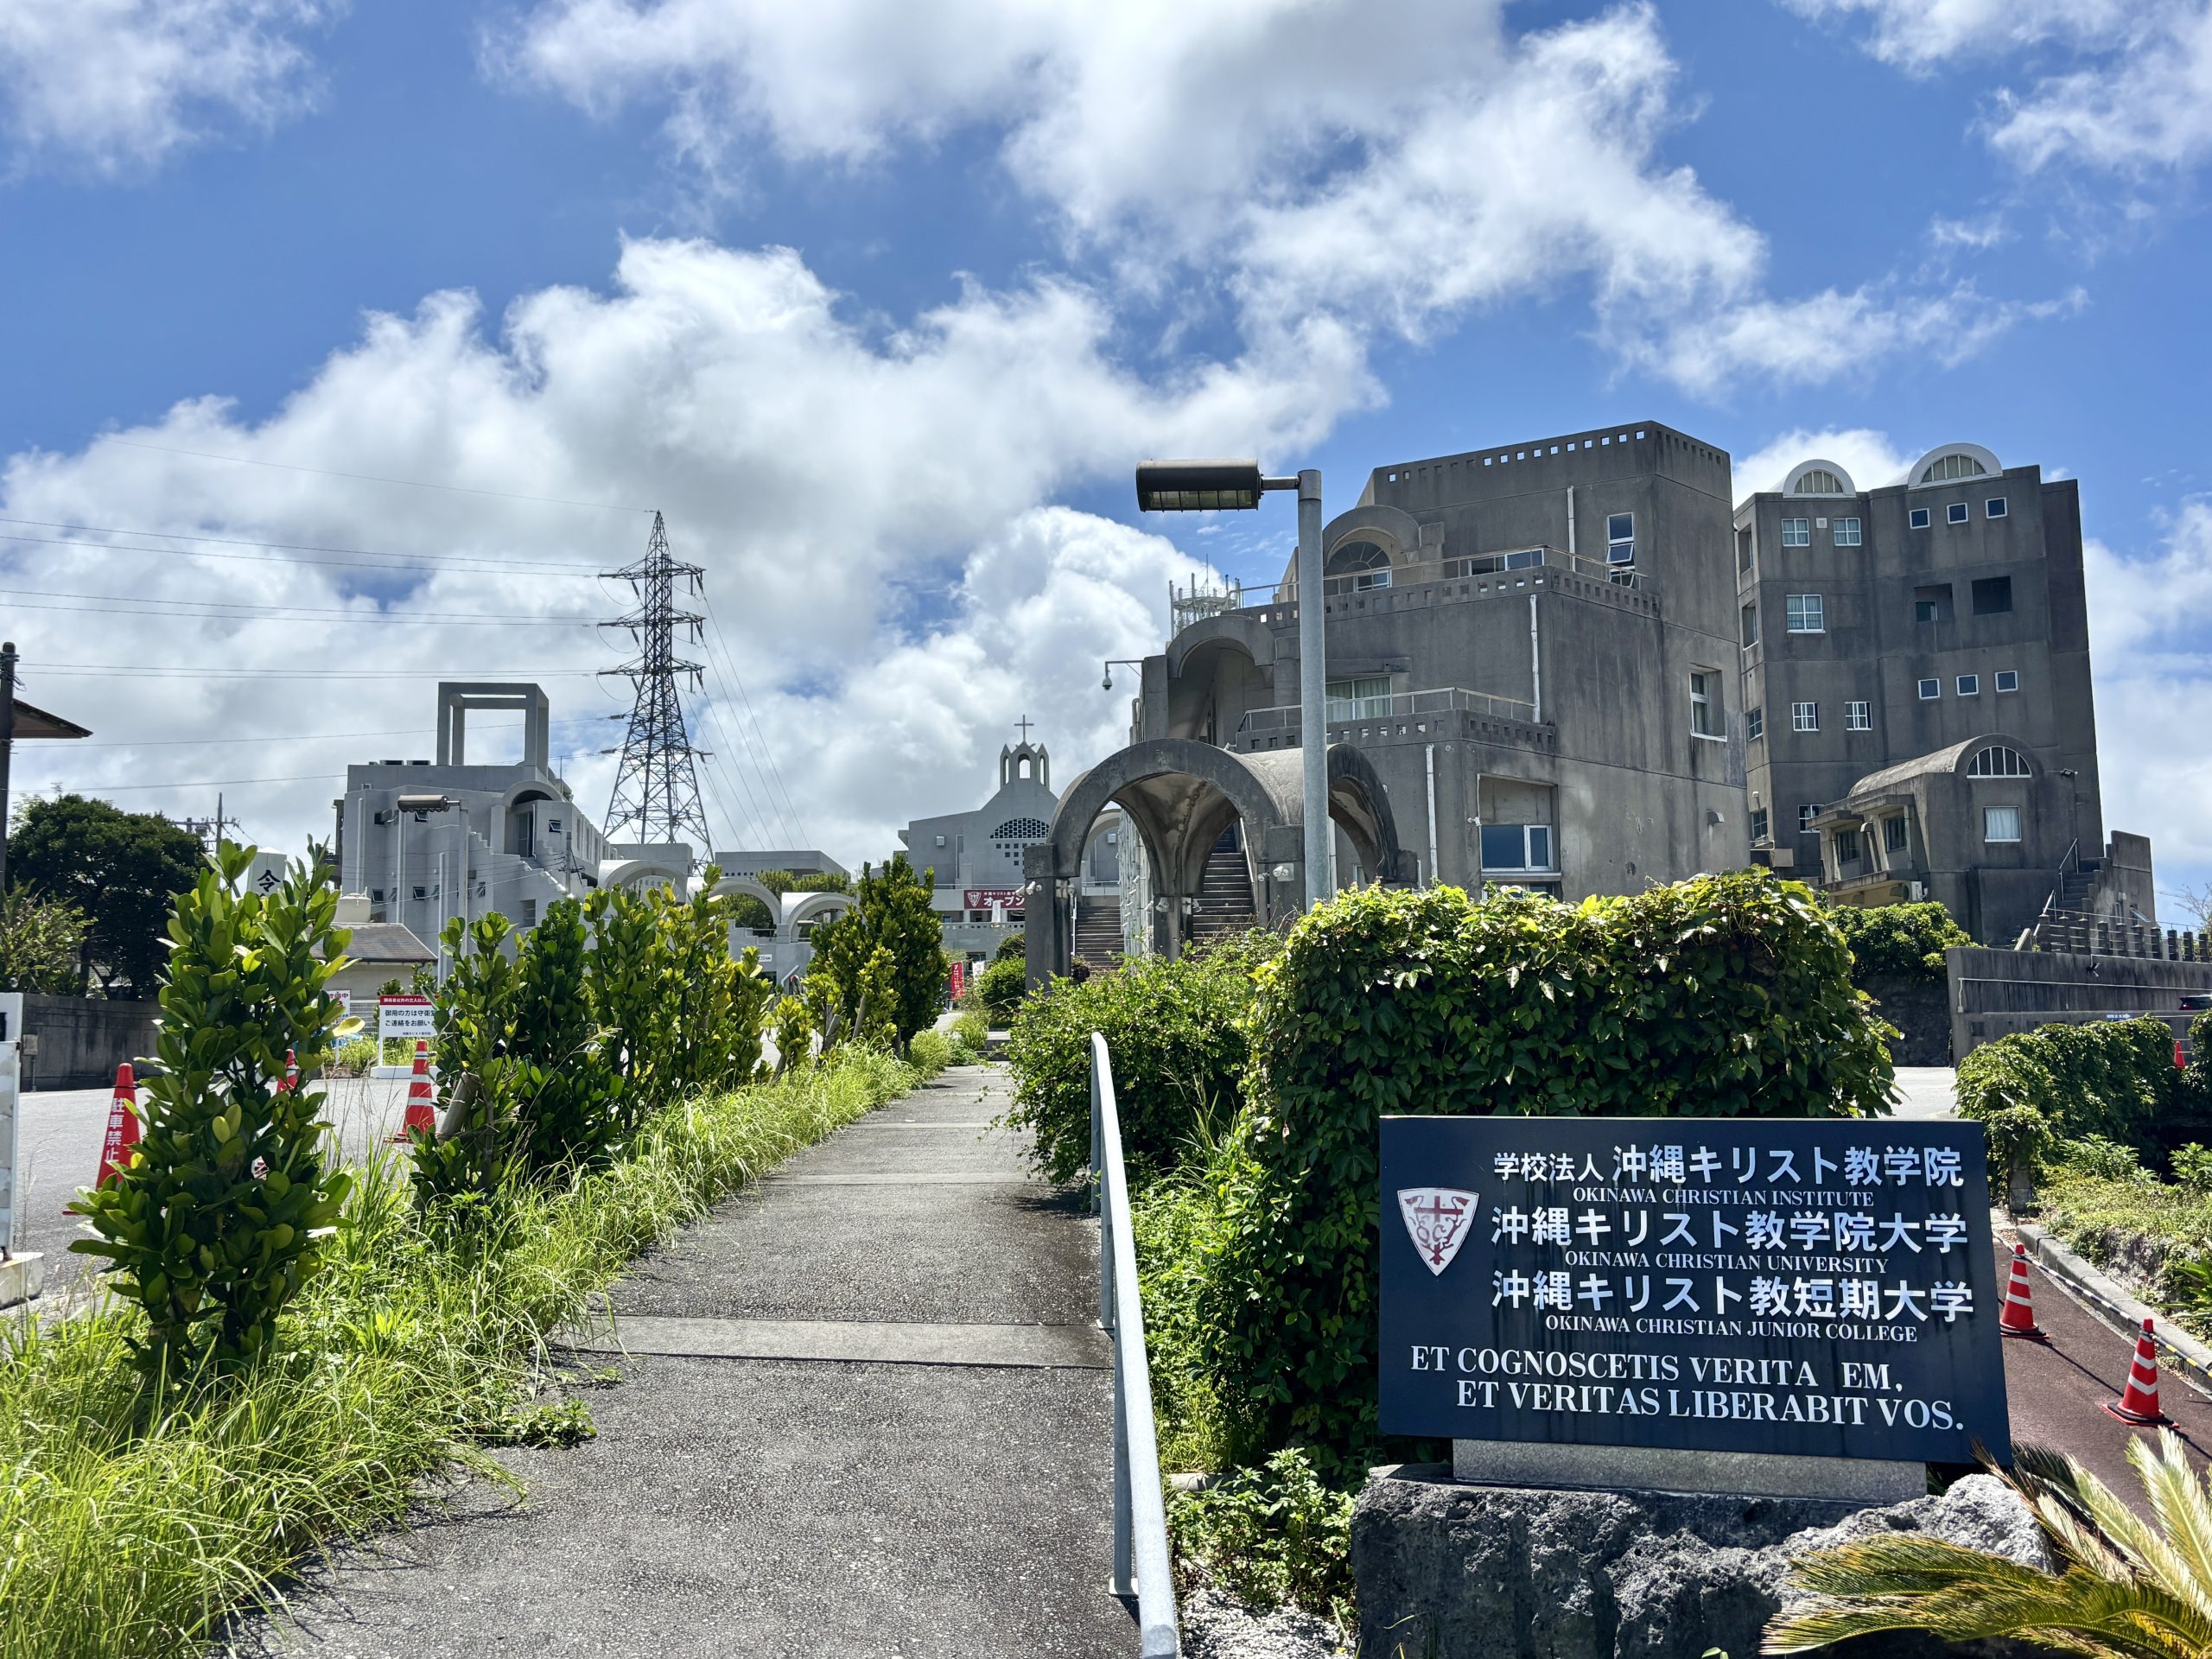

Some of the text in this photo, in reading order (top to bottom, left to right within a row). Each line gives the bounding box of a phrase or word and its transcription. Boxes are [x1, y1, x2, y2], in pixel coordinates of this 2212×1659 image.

[257, 869, 281, 897] 令
[105, 1097, 125, 1162] 駐車禁止
[1573, 1187, 1874, 1207] OKINAWA CHRISTIAN INSTITUTE
[1491, 1205, 1968, 1254] 沖縄キリスト教学院大学
[1565, 1250, 1889, 1274] OKINAWA CHRISTIAN UNIVERSITY
[1491, 1268, 1974, 1323] 沖縄キリスト教短期大学
[1545, 1314, 1917, 1343] OKINAWA CHRISTIAN JUNIOR COLLEGE
[1410, 1345, 1450, 1371] ET
[1458, 1347, 1680, 1381] COGNOSCETIS
[1456, 1380, 1964, 1431] ET VERITAS LIBERABIT VOS.
